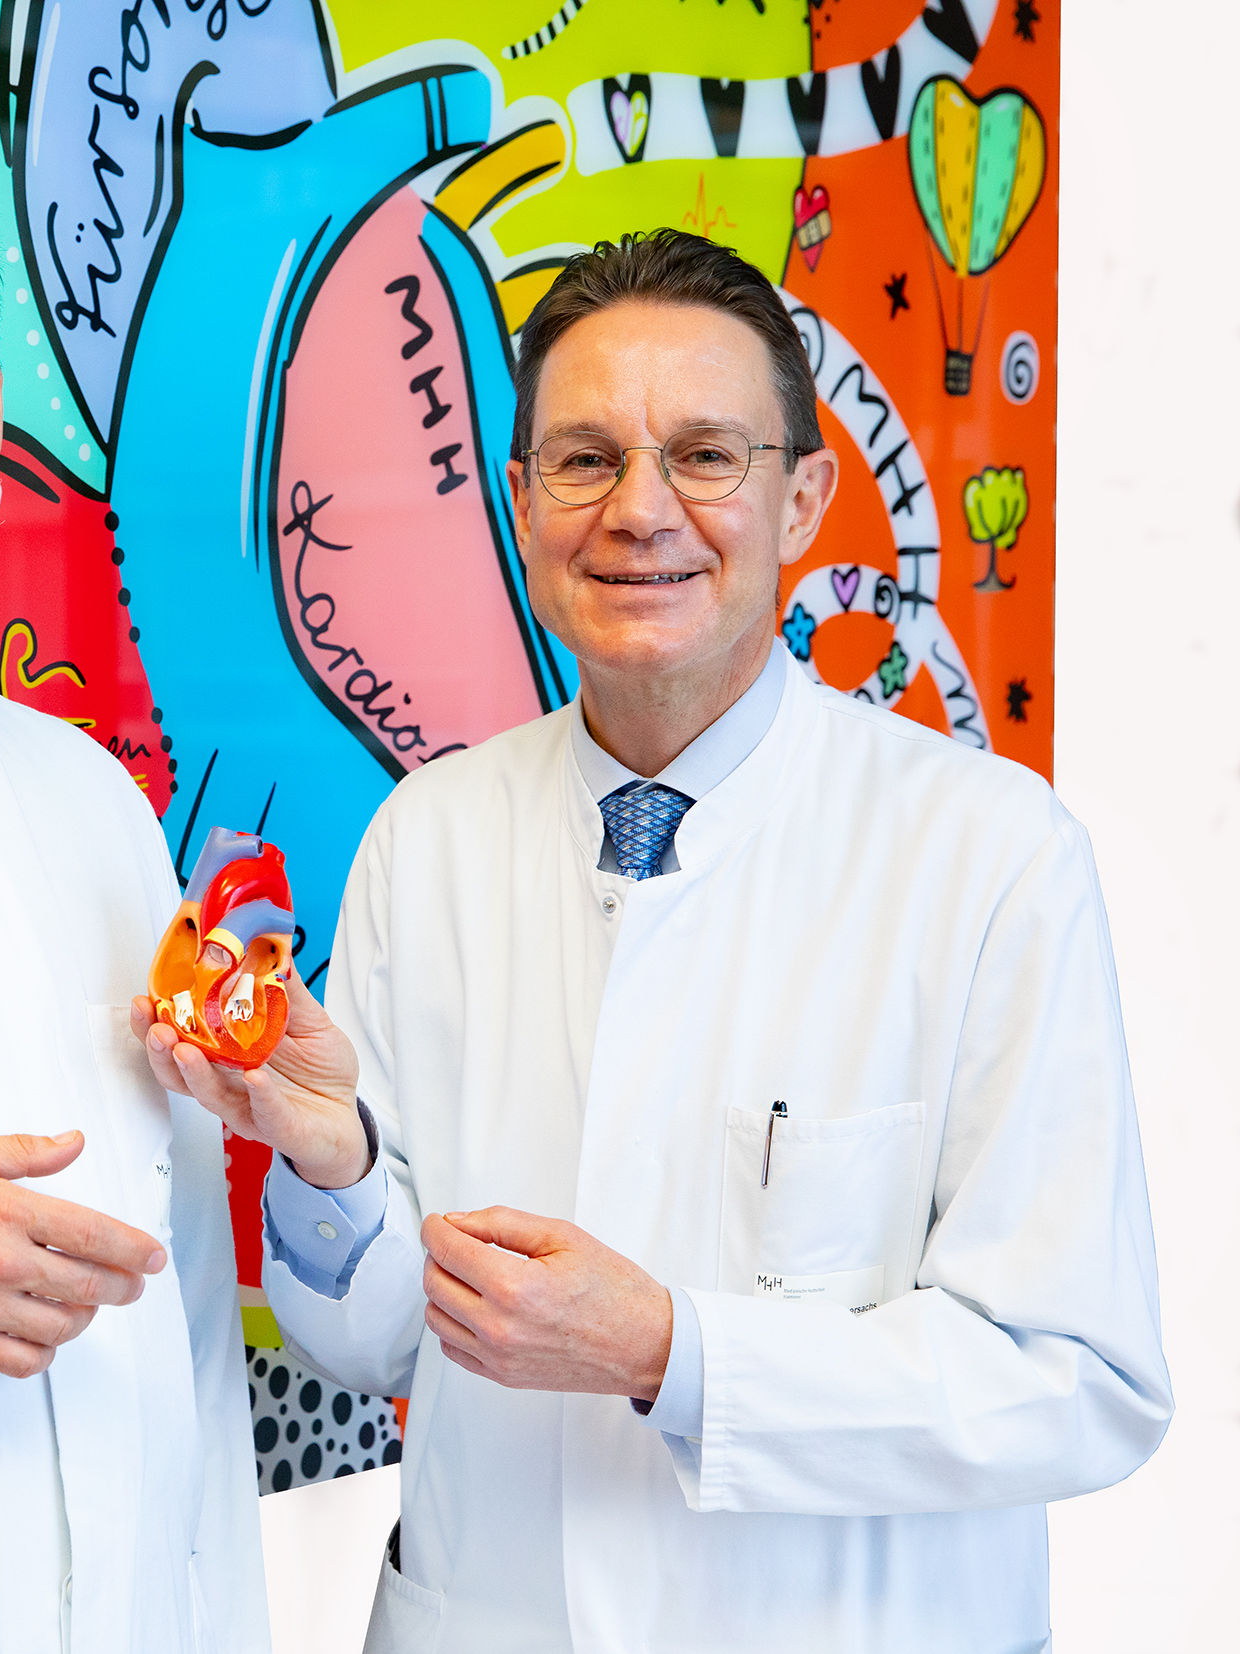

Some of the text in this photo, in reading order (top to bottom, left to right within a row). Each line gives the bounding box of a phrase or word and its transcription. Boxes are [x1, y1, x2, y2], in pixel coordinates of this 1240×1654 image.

[46, 0, 274, 338] Fürso
[384, 274, 468, 496] MHH
[281, 479, 468, 764] Kardio
[757, 1274, 783, 1292] MHH
